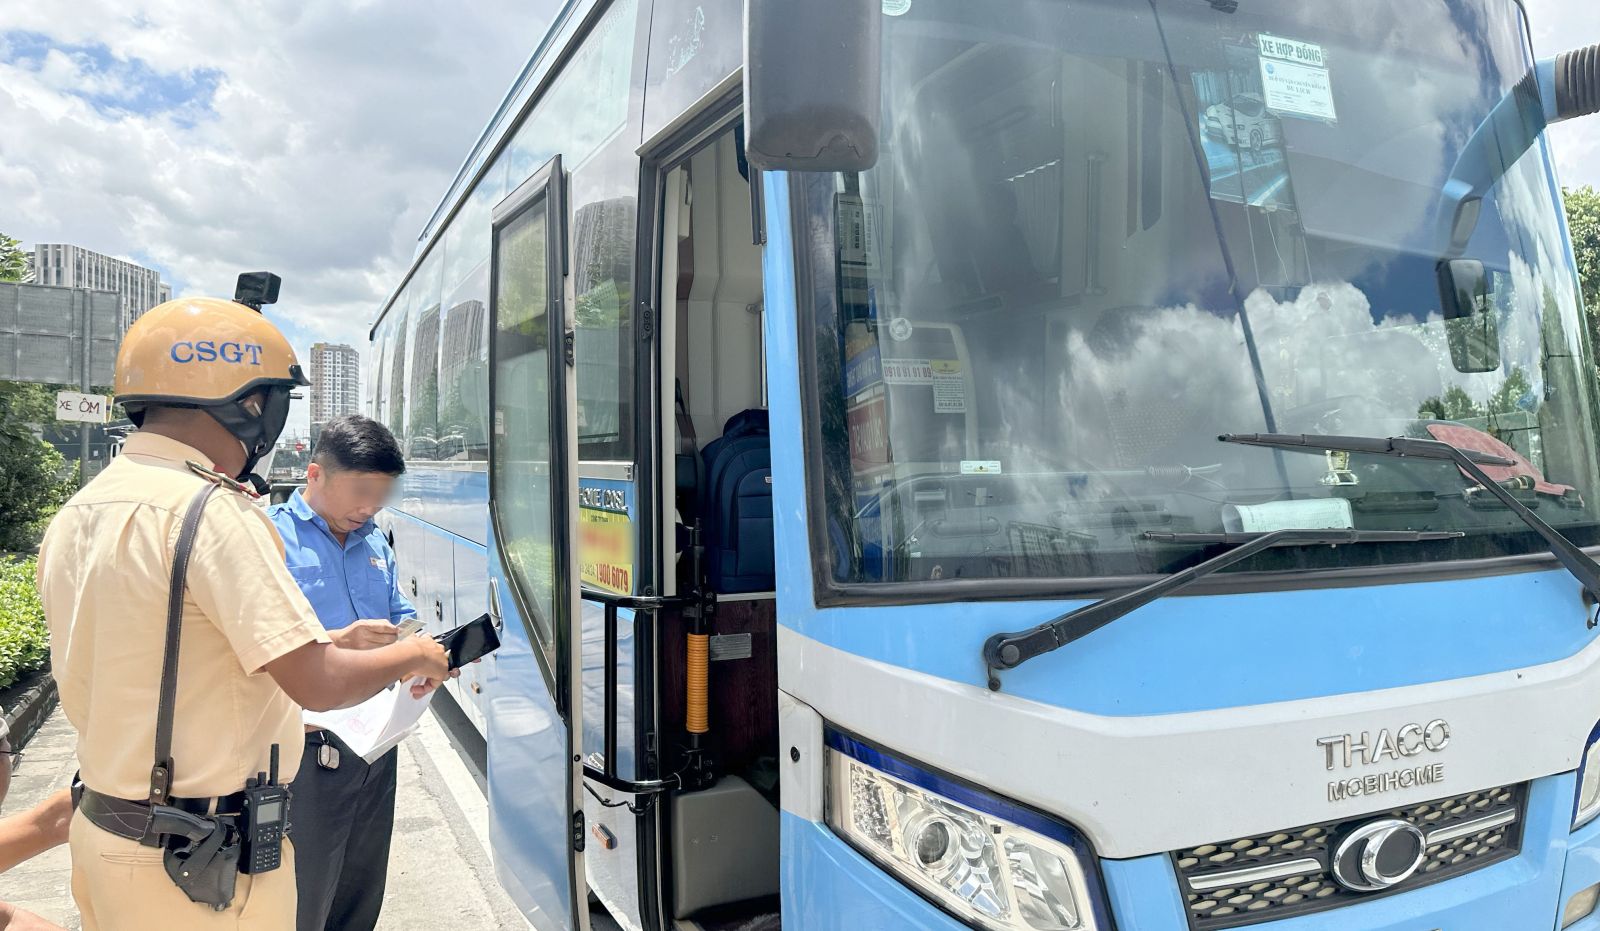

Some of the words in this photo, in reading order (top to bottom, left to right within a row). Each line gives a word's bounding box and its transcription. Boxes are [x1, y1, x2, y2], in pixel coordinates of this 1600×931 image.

[1261, 39, 1275, 53] XE
[1276, 41, 1294, 58] HỢP
[170, 341, 263, 366] CSGT
[59, 400, 72, 410] XE
[79, 397, 100, 414] ÔM
[596, 563, 611, 586] 1900
[611, 565, 629, 593] 6079
[1316, 718, 1451, 770] THACO
[1327, 763, 1445, 802] MOBIHOME
